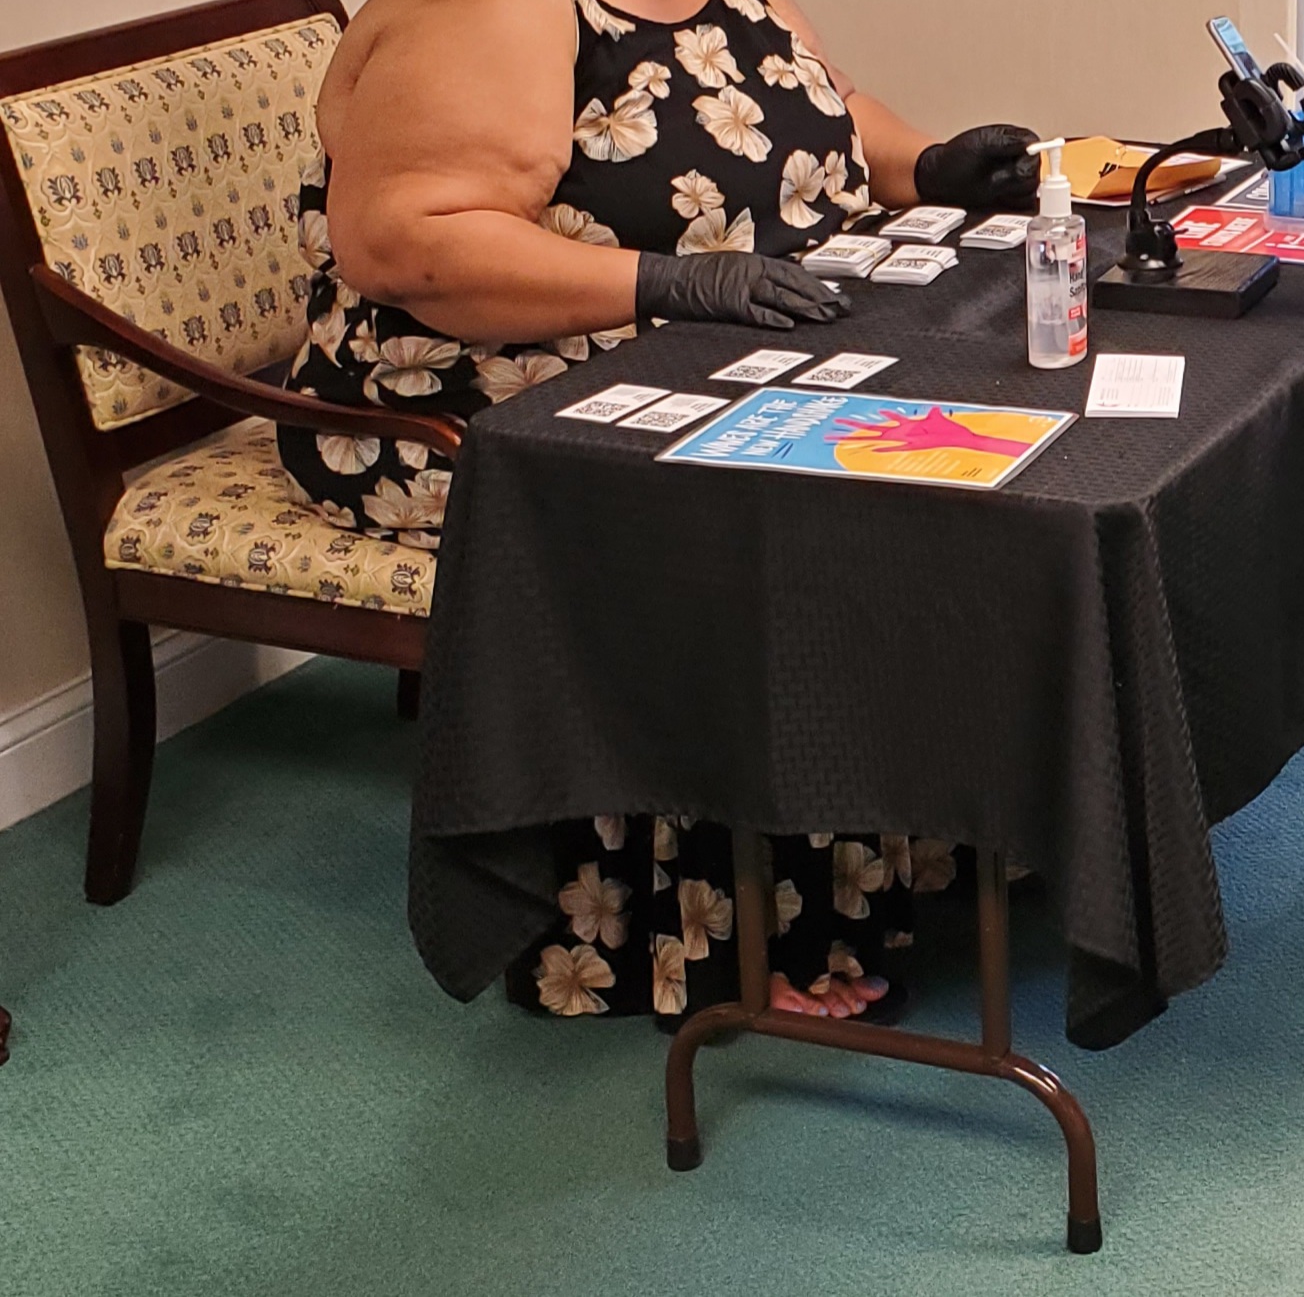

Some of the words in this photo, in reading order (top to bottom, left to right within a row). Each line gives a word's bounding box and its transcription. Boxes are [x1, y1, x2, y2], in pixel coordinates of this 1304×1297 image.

[690, 430, 758, 457] WAVES
[734, 413, 779, 432] ARE
[757, 398, 798, 414] THE
[739, 438, 781, 457] NEW
[760, 395, 849, 440] HANDSHAKE
